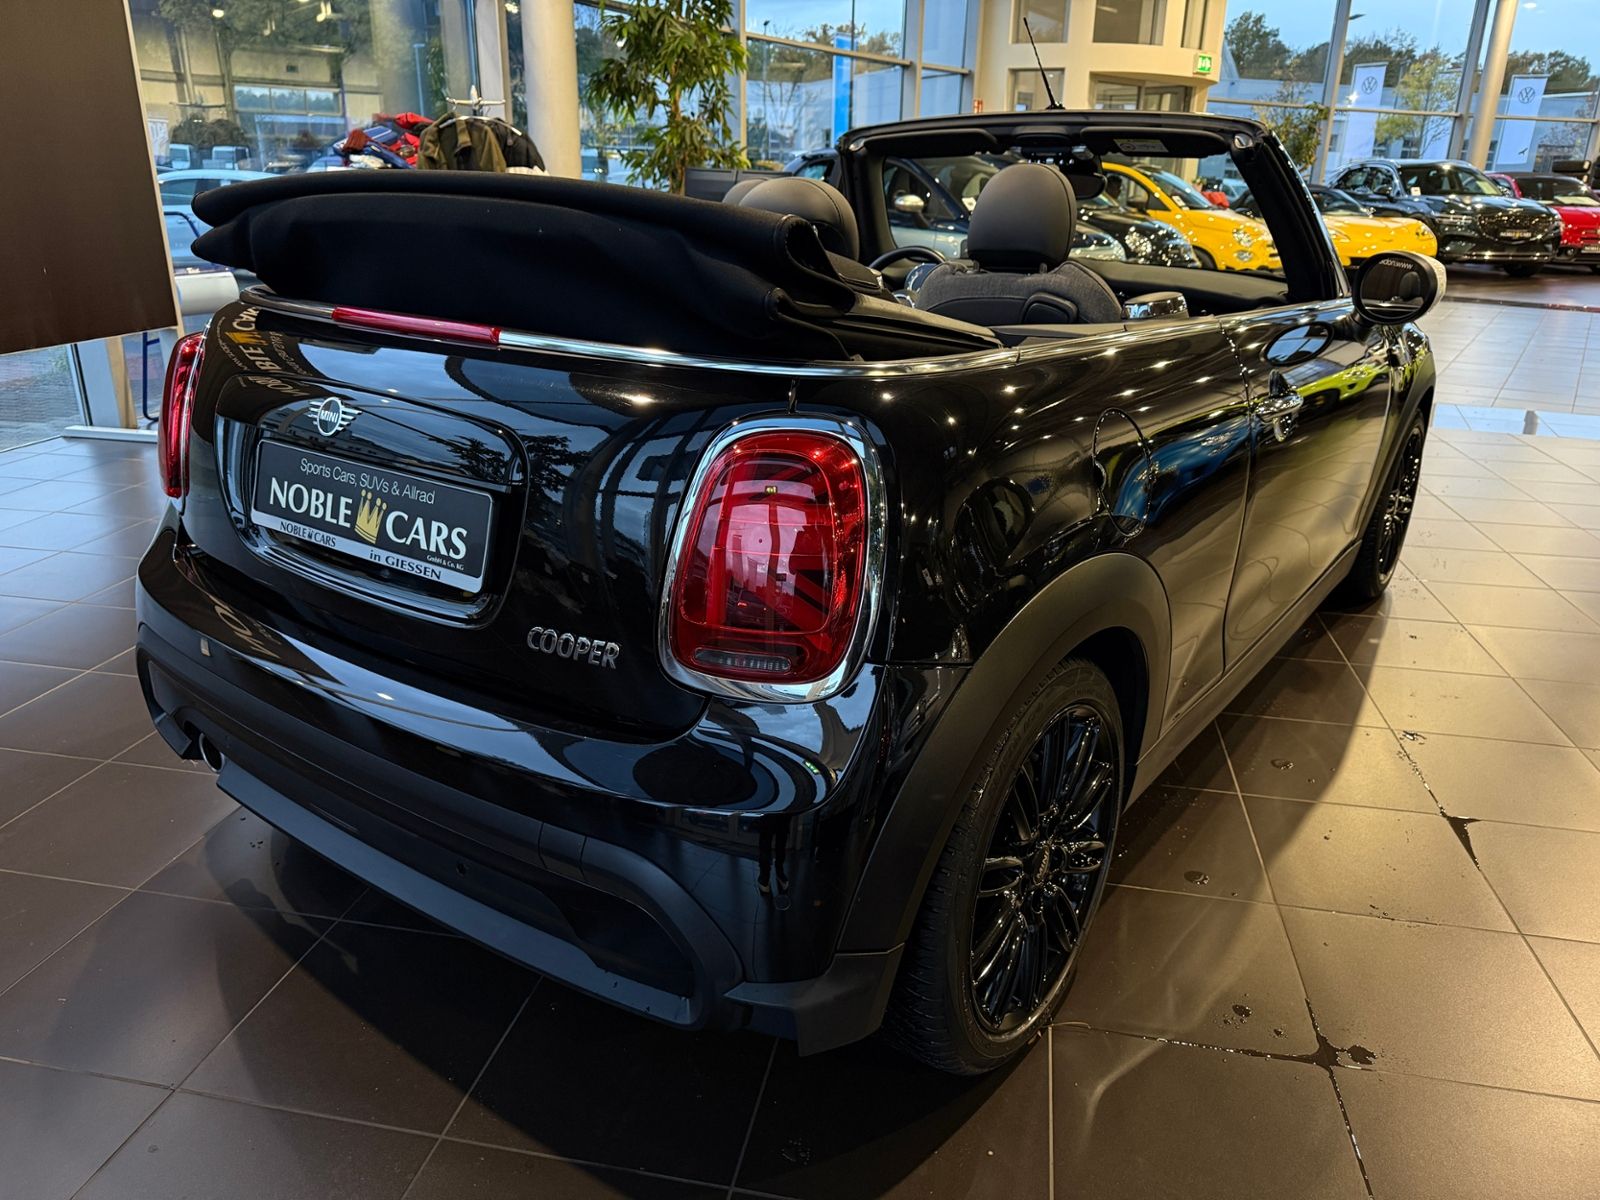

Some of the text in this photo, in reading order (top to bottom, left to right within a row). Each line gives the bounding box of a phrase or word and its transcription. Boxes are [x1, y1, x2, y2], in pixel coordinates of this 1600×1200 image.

[320, 409, 339, 424] MINI
[300, 458, 435, 505] Sports Cars, SUVs & Allrad
[269, 477, 468, 559] NOBLE CARS
[280, 521, 336, 548] NOBLE CARS
[369, 550, 441, 580] in GIESSEN
[526, 626, 620, 670] COOPER
